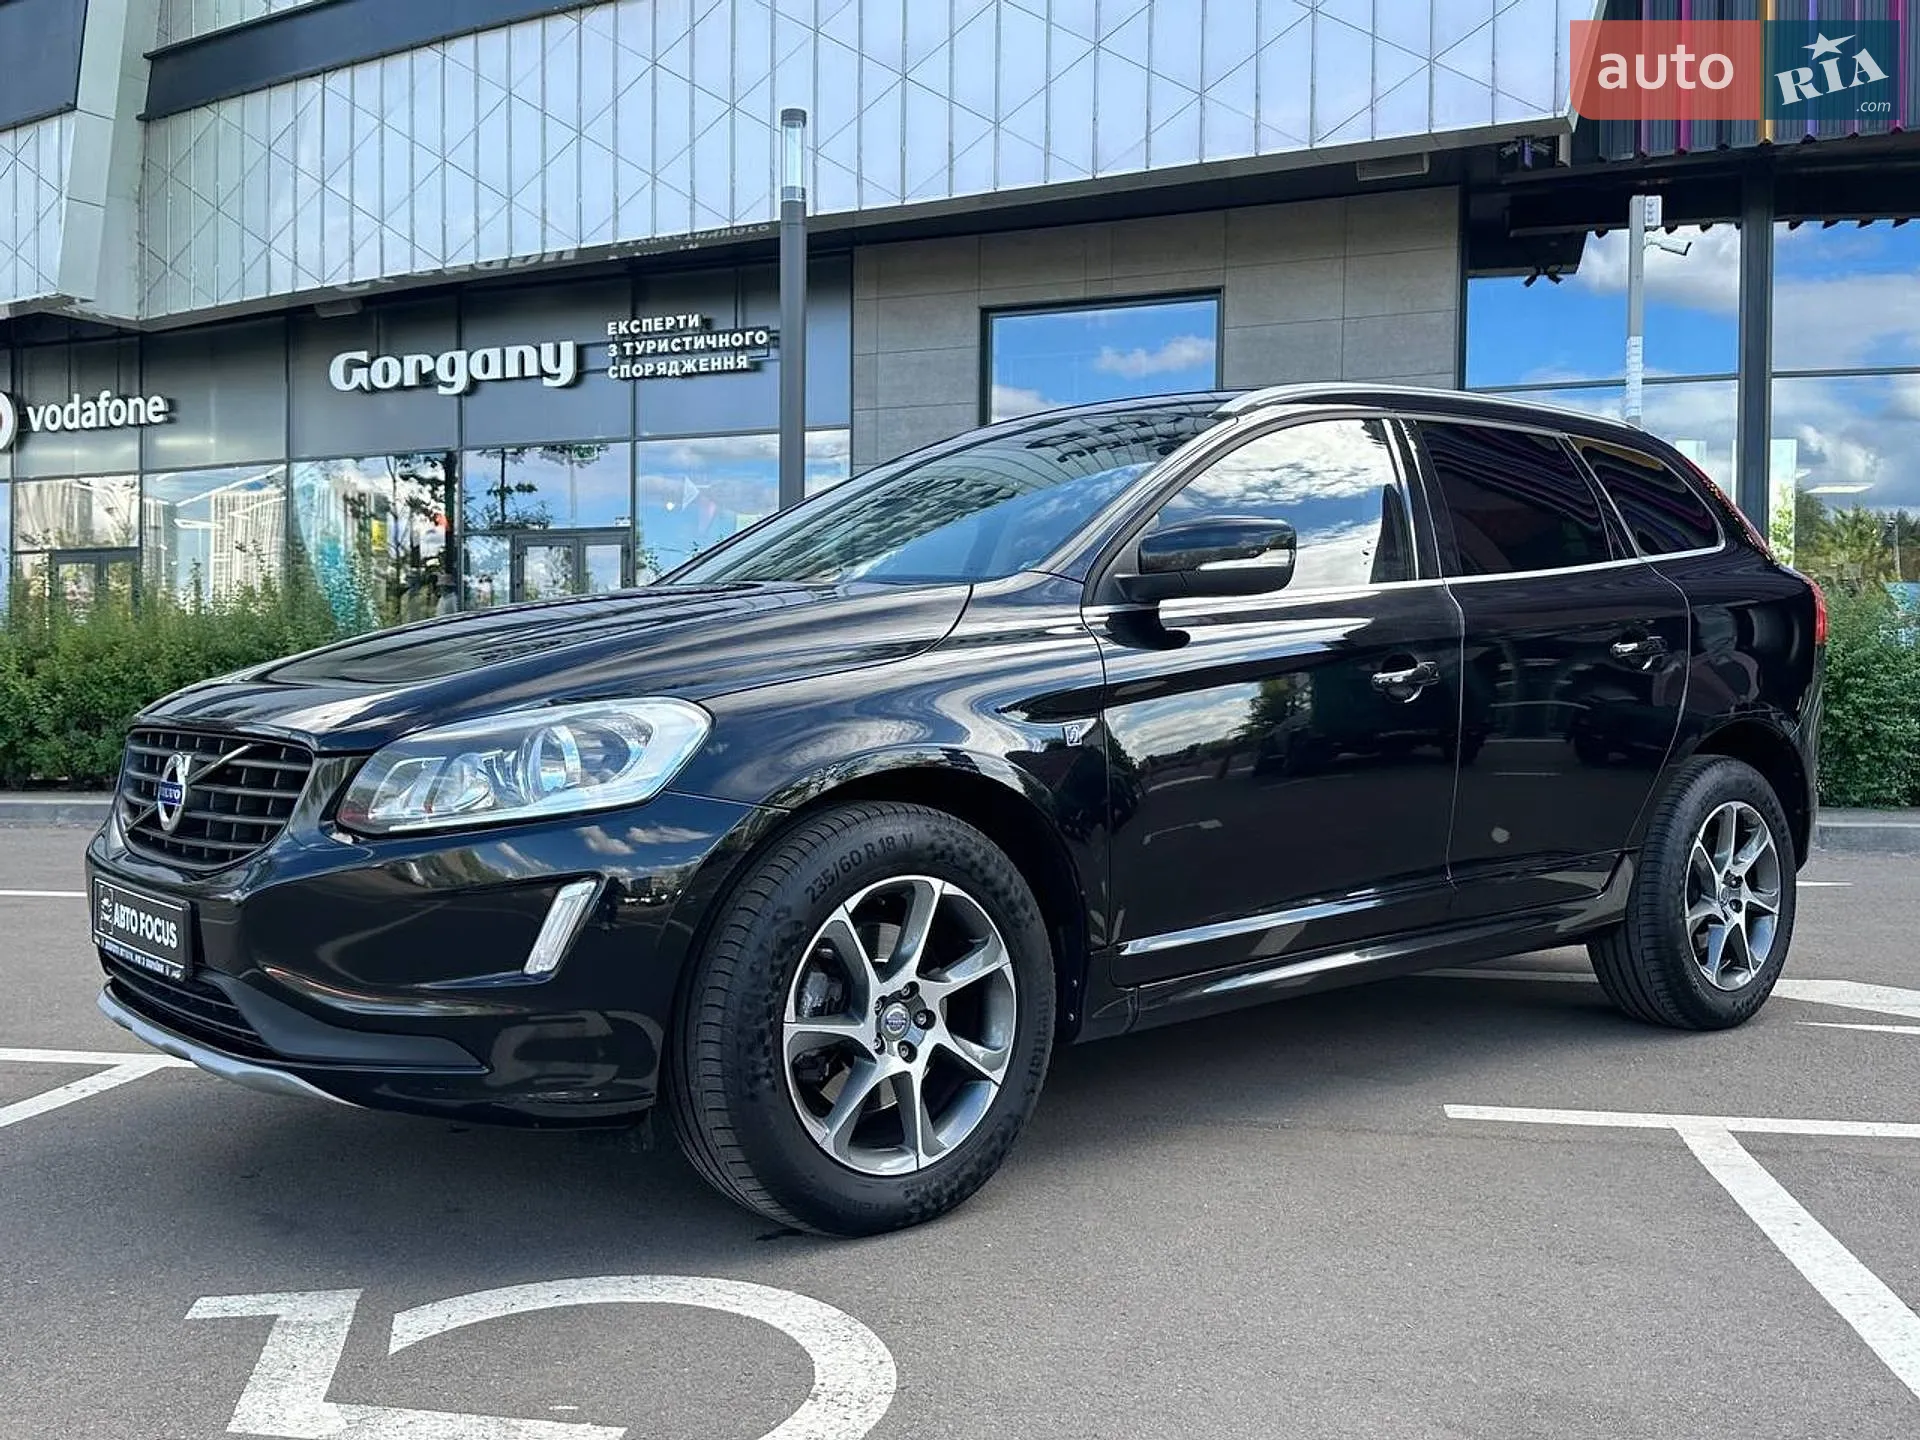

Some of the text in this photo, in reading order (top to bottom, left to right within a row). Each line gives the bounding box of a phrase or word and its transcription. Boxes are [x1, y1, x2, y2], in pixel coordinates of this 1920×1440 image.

[607, 314, 699, 335] ЕКСПЕРТИ
[623, 330, 768, 356] ТУРИСТИЧНОГО
[329, 341, 576, 395] Gorgany
[608, 356, 748, 379] СПОРЯДЖЕННЯ
[27, 390, 168, 432] vodafone
[804, 849, 862, 904] 235/60
[139, 911, 178, 949] FOCUS
